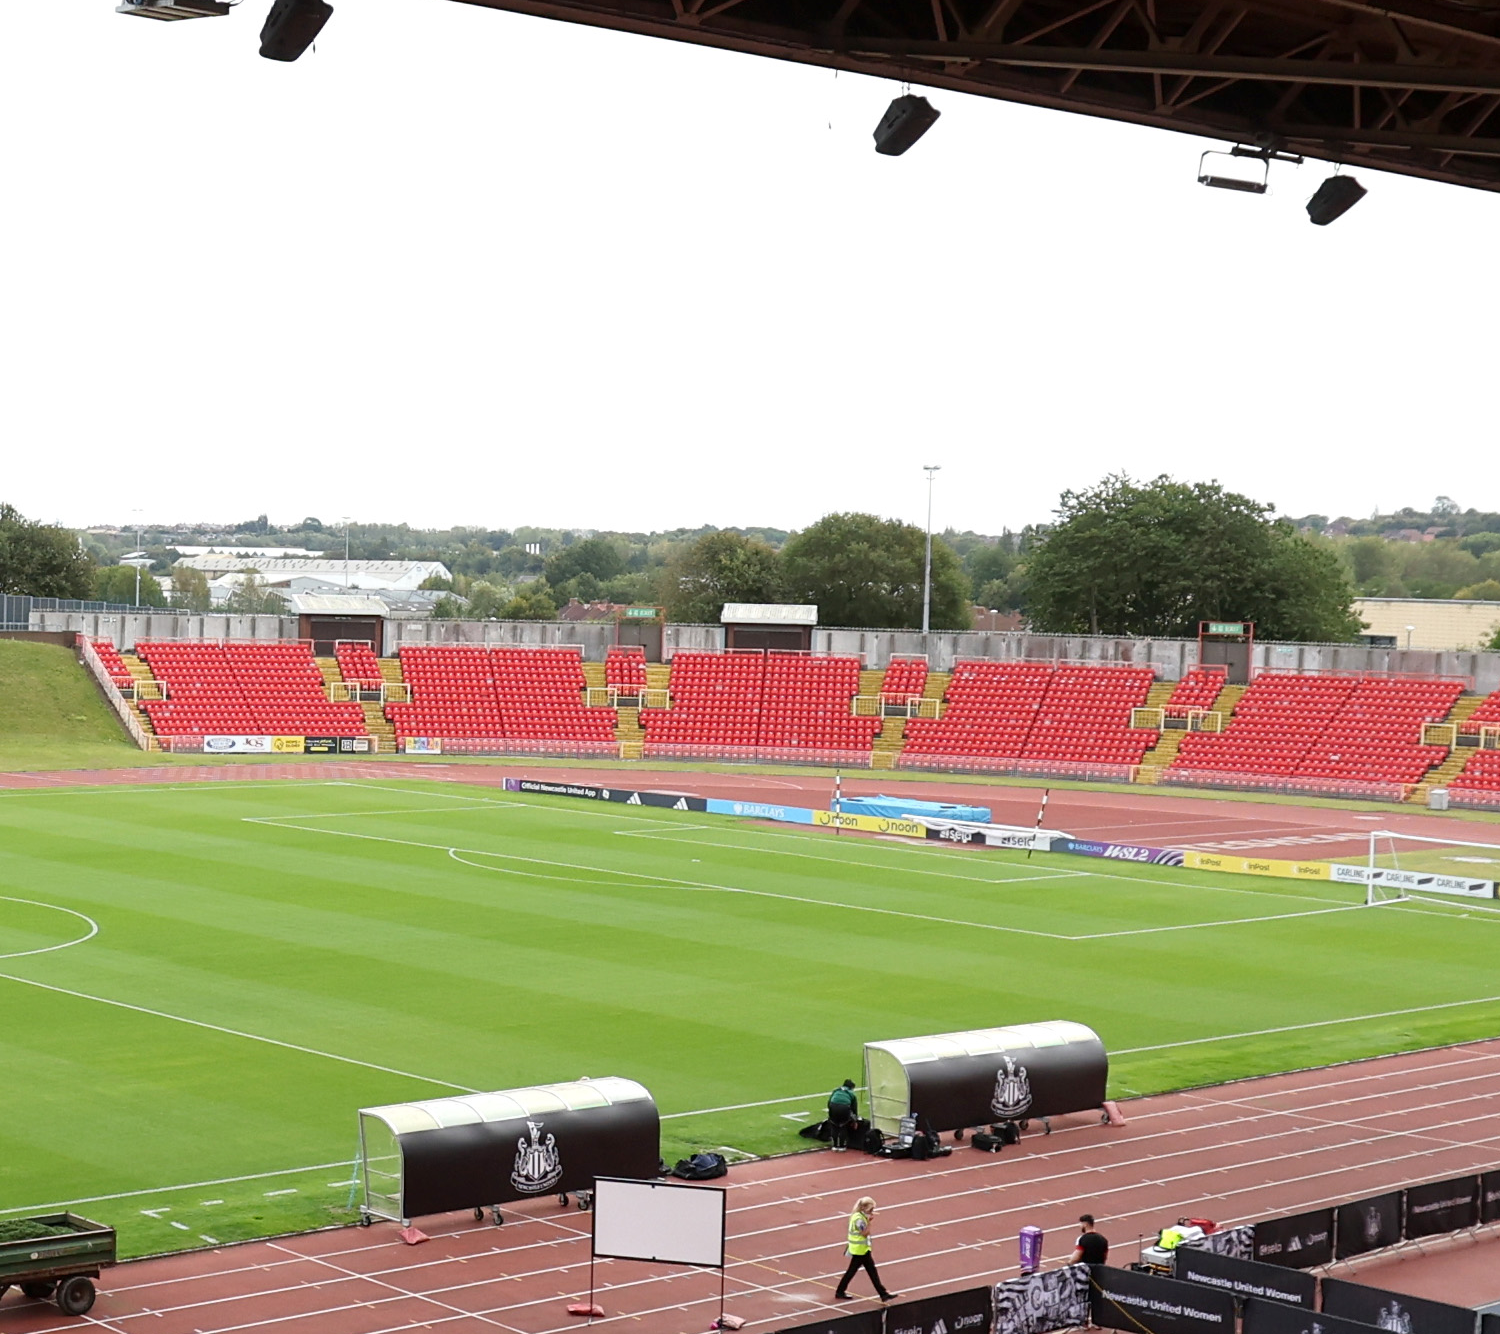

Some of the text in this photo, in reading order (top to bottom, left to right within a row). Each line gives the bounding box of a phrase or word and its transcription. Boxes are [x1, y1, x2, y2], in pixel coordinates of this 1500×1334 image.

[521, 782, 596, 798] Official Newcastle United App
[743, 803, 785, 818] BARCLAYS
[890, 822, 918, 834] noon
[1075, 843, 1149, 862] BARCLAYS WSL2
[1336, 867, 1365, 879] CARLING
[1386, 872, 1415, 884] CARLING
[1436, 877, 1466, 890] CARLING
[1187, 1270, 1302, 1304] Newcastle United Women
[1102, 1289, 1148, 1308] Newcastle
[1150, 1298, 1182, 1316] United
[1183, 1306, 1223, 1323] Women
